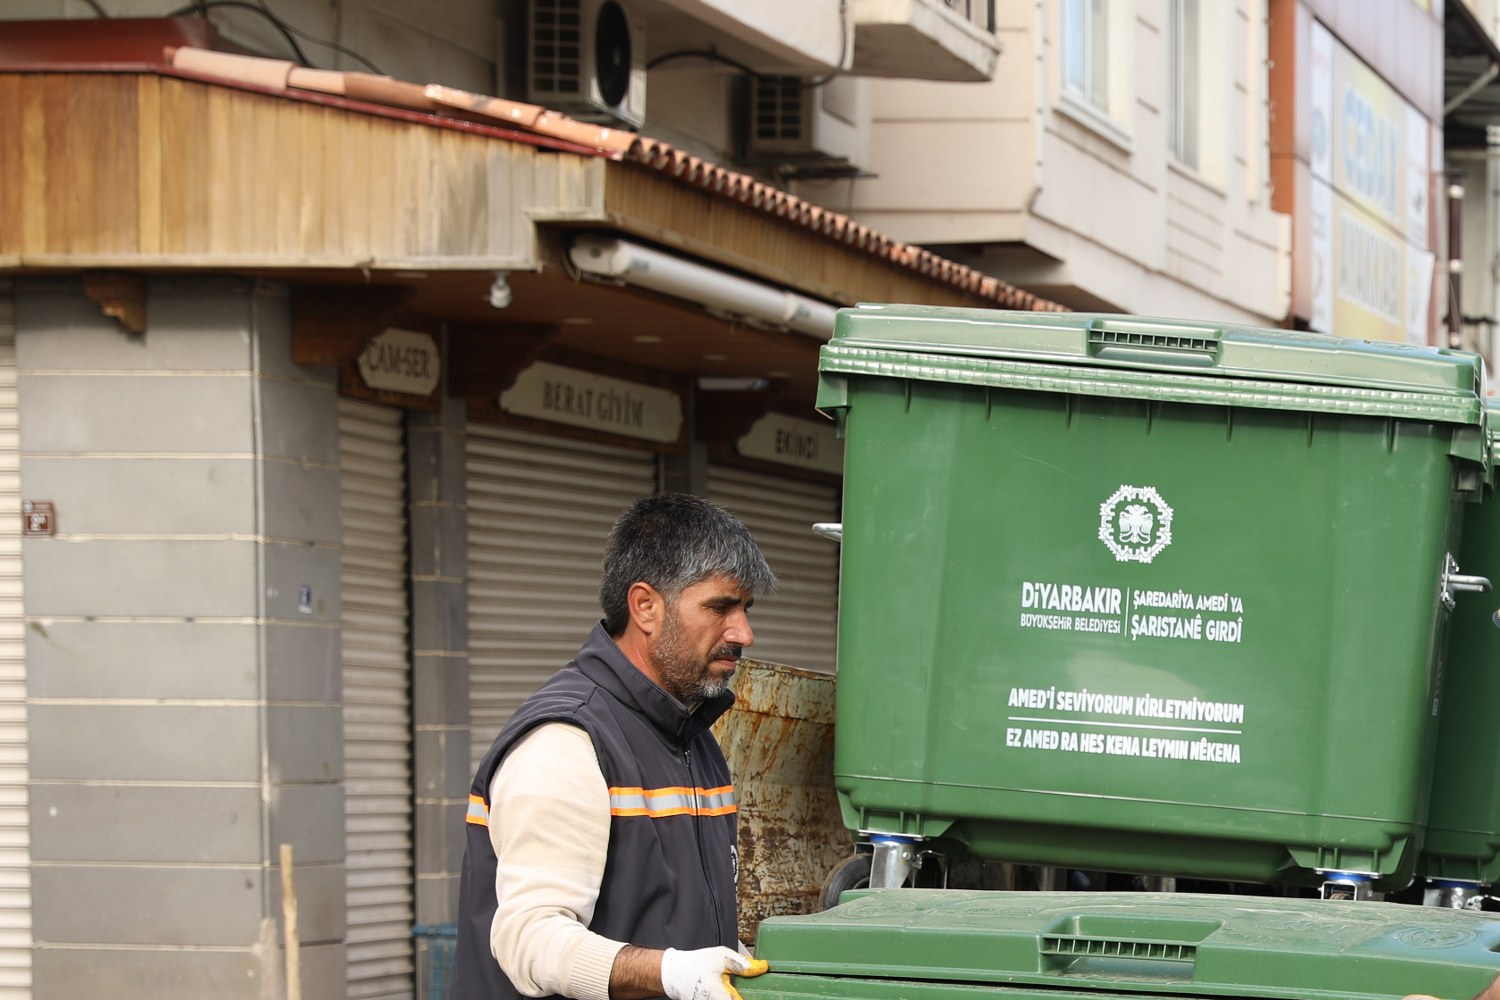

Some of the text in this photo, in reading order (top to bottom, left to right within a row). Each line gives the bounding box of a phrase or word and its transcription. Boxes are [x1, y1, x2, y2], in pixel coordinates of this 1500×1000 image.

[542, 379, 645, 429] BERAT GİYİM
[1133, 588, 1244, 613] ŞAREDARÎYA AMEDÎ YA
[1131, 613, 1244, 643] ŞARISTANÊ GIRDÎ
[1008, 686, 1244, 723] AMED'İ SEVİYORUM KİRLETMİYORUM
[1006, 728, 1241, 764] EZ AMED RA HES KENA LEYMIN NÊKENA
